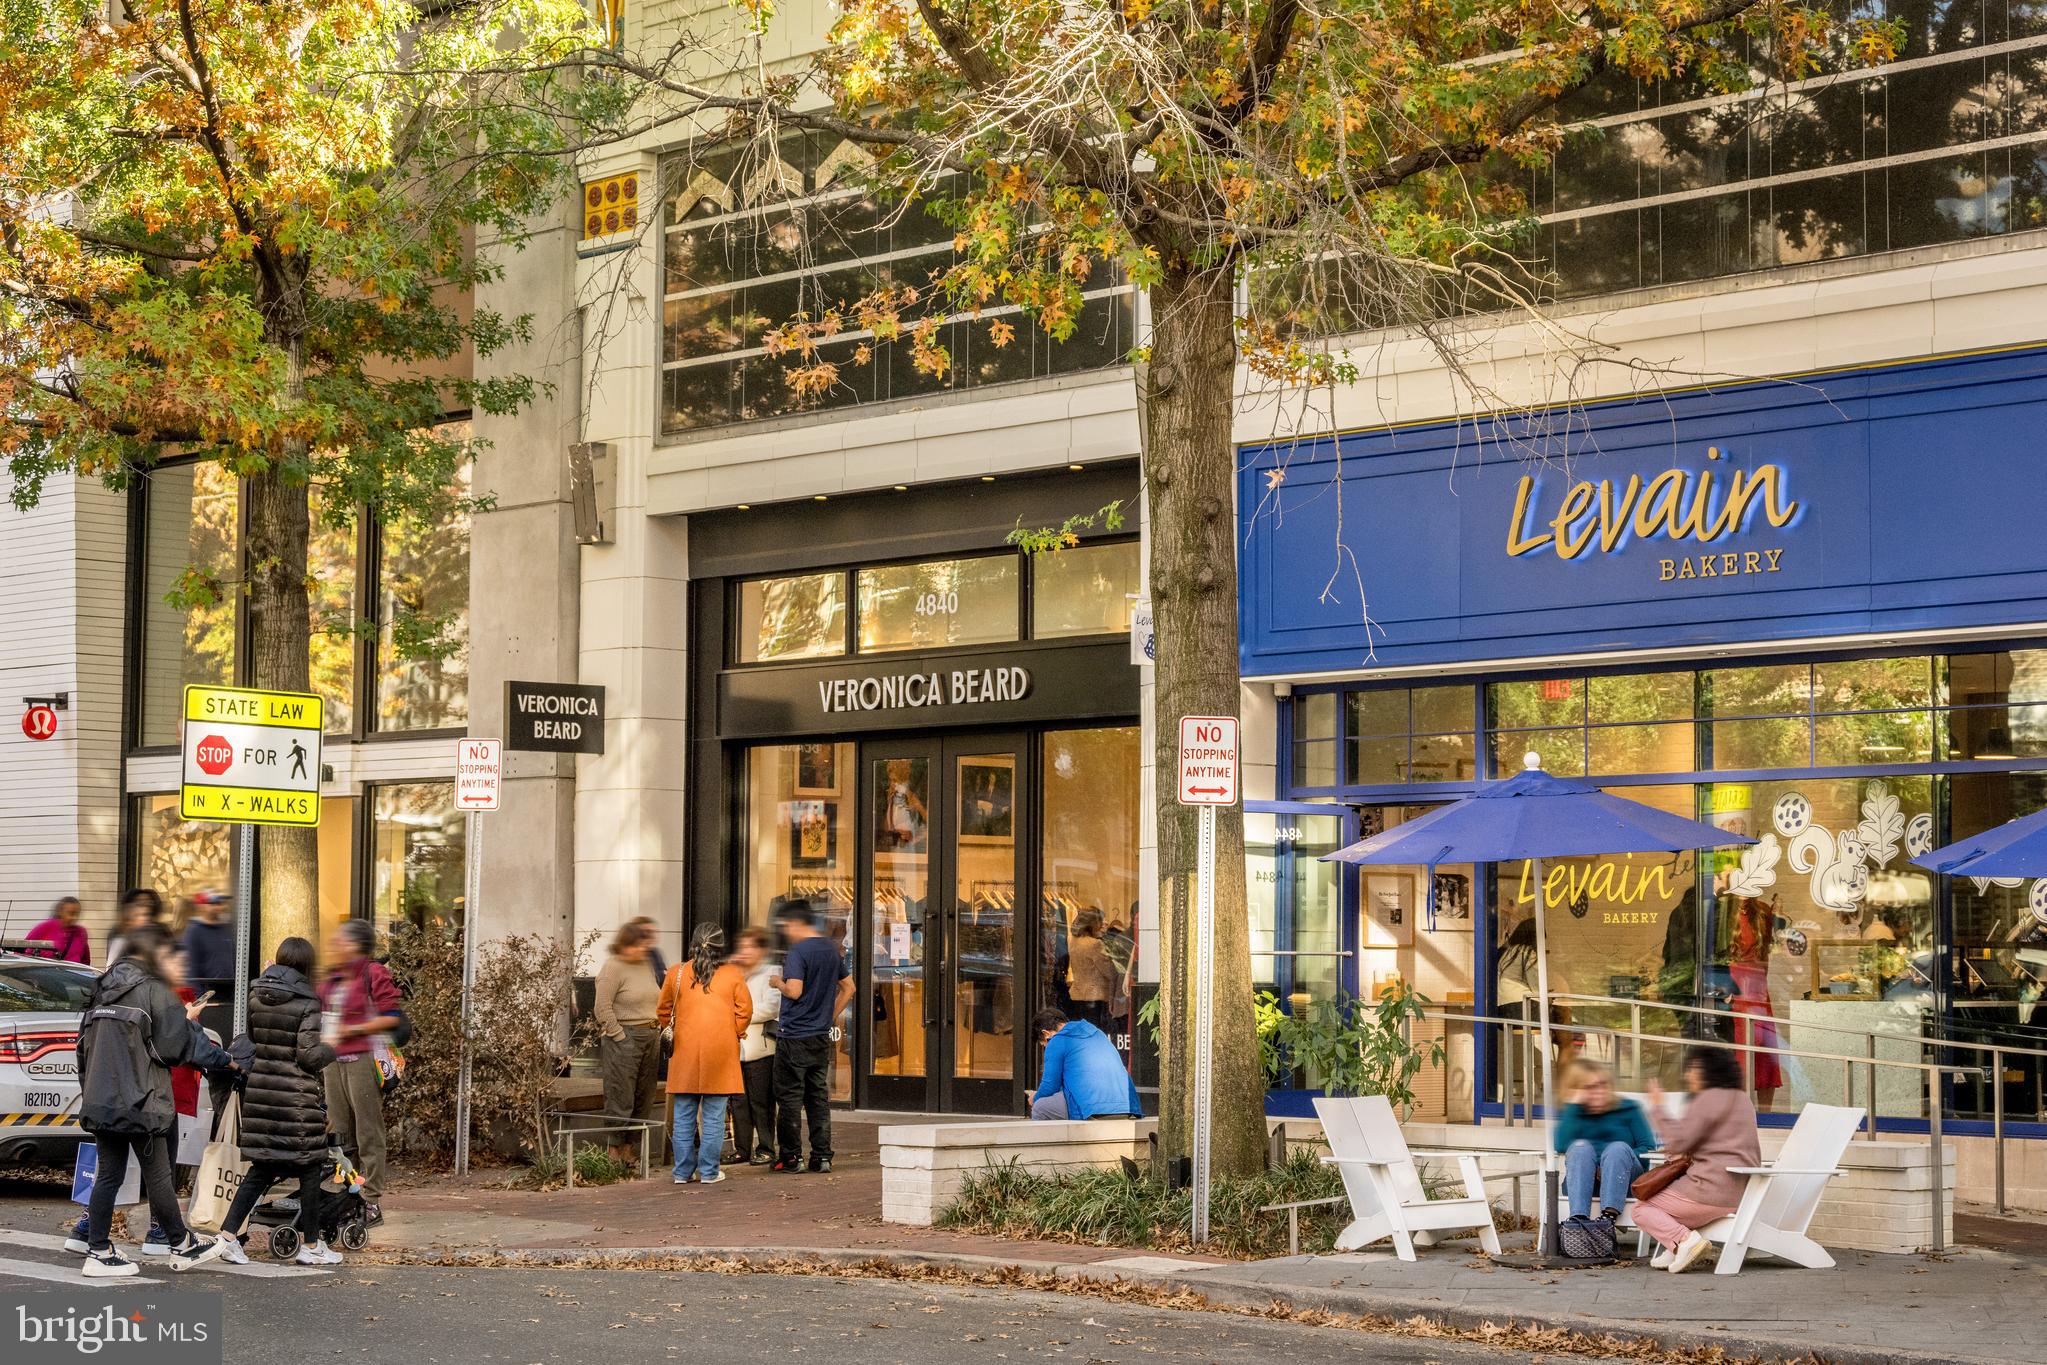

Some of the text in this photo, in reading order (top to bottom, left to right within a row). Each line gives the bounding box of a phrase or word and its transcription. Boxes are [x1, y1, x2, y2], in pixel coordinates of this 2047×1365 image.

[1506, 446, 1799, 560] Levain
[1659, 549, 1784, 581] BAKERY
[915, 592, 959, 616] 4840
[819, 666, 1029, 713] VERONICA BEARD
[206, 697, 304, 720] STATE LAW
[517, 694, 598, 716] VERONICA
[534, 720, 581, 740] BEARD
[1196, 726, 1222, 743] NO
[198, 746, 277, 766] STOP FOR
[469, 746, 489, 760] NO
[1183, 748, 1234, 760] STOPPING
[459, 764, 498, 774] STOPPING
[1185, 766, 1231, 778] ANYTIME
[461, 779, 495, 789] ANYTIME
[193, 795, 205, 807] IN
[1517, 852, 1675, 908] Levain
[1603, 912, 1659, 924] BAKERY
[28, 1063, 79, 1075] COUN
[24, 1092, 61, 1107] 1821130
[217, 1167, 243, 1187] 100
